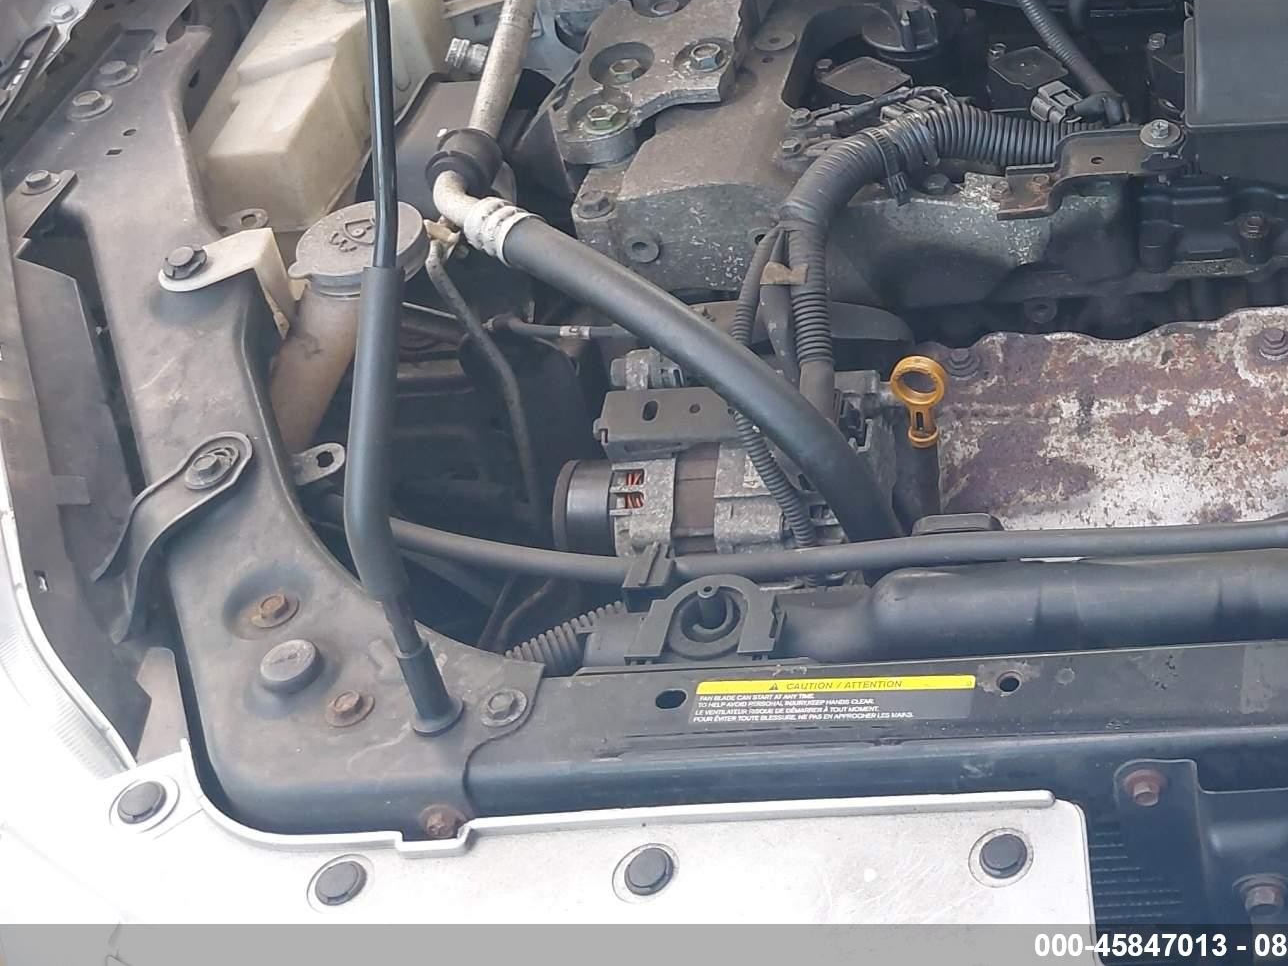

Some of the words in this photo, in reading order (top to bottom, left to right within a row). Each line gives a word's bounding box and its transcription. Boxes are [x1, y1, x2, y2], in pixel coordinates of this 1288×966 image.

[786, 682, 833, 690] CAUTION
[844, 680, 903, 689] ATTENTION
[748, 707, 774, 715] RISQUE
[834, 712, 876, 720] APPROCHER
